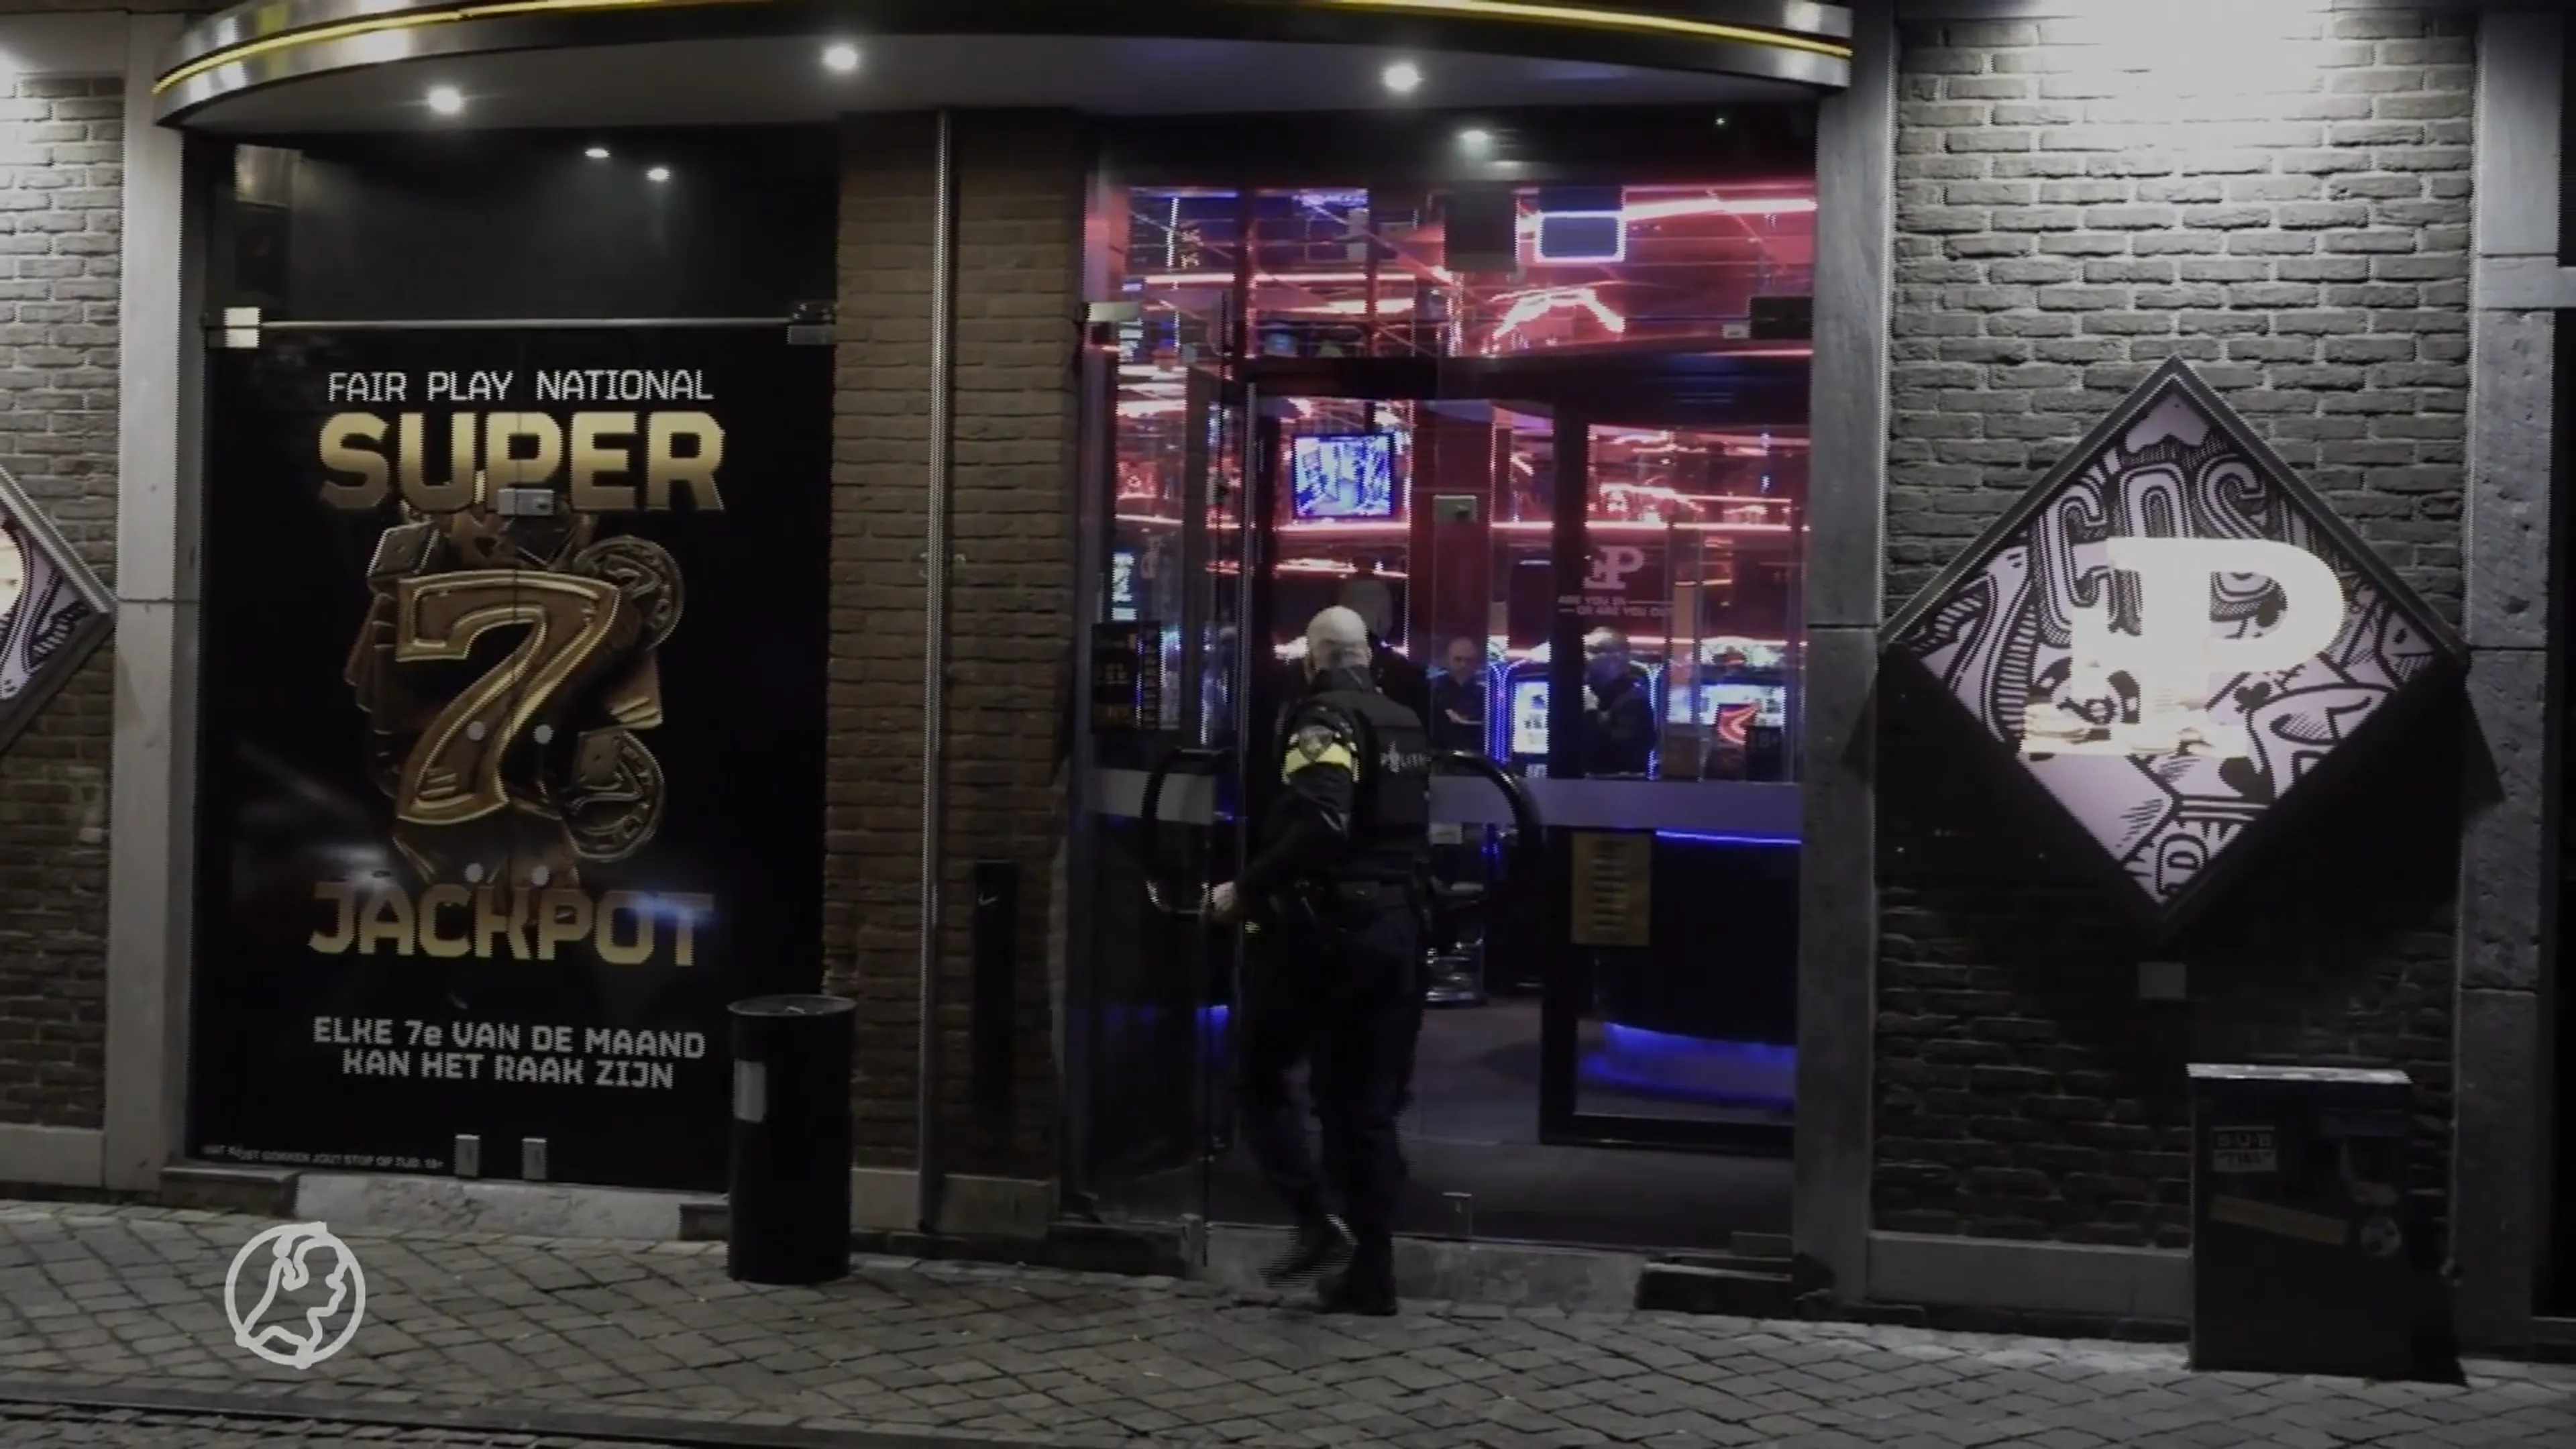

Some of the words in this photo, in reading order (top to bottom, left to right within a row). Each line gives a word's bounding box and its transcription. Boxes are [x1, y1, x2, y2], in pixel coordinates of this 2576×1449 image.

[328, 371, 407, 402] FAIR
[427, 370, 514, 401] PLAY
[536, 369, 714, 400] NATIONAL
[319, 411, 726, 512] SUPER
[307, 880, 714, 967] JACKPOT
[313, 1016, 393, 1045] ELKE
[405, 1019, 443, 1047] 7e
[451, 1020, 521, 1051] VAN
[531, 1025, 573, 1053] DE
[584, 1027, 706, 1059] MAAND
[343, 1048, 410, 1077] KAN
[421, 1051, 484, 1079] HET
[494, 1054, 585, 1084] RAAK
[596, 1059, 674, 1089] ZIJN
